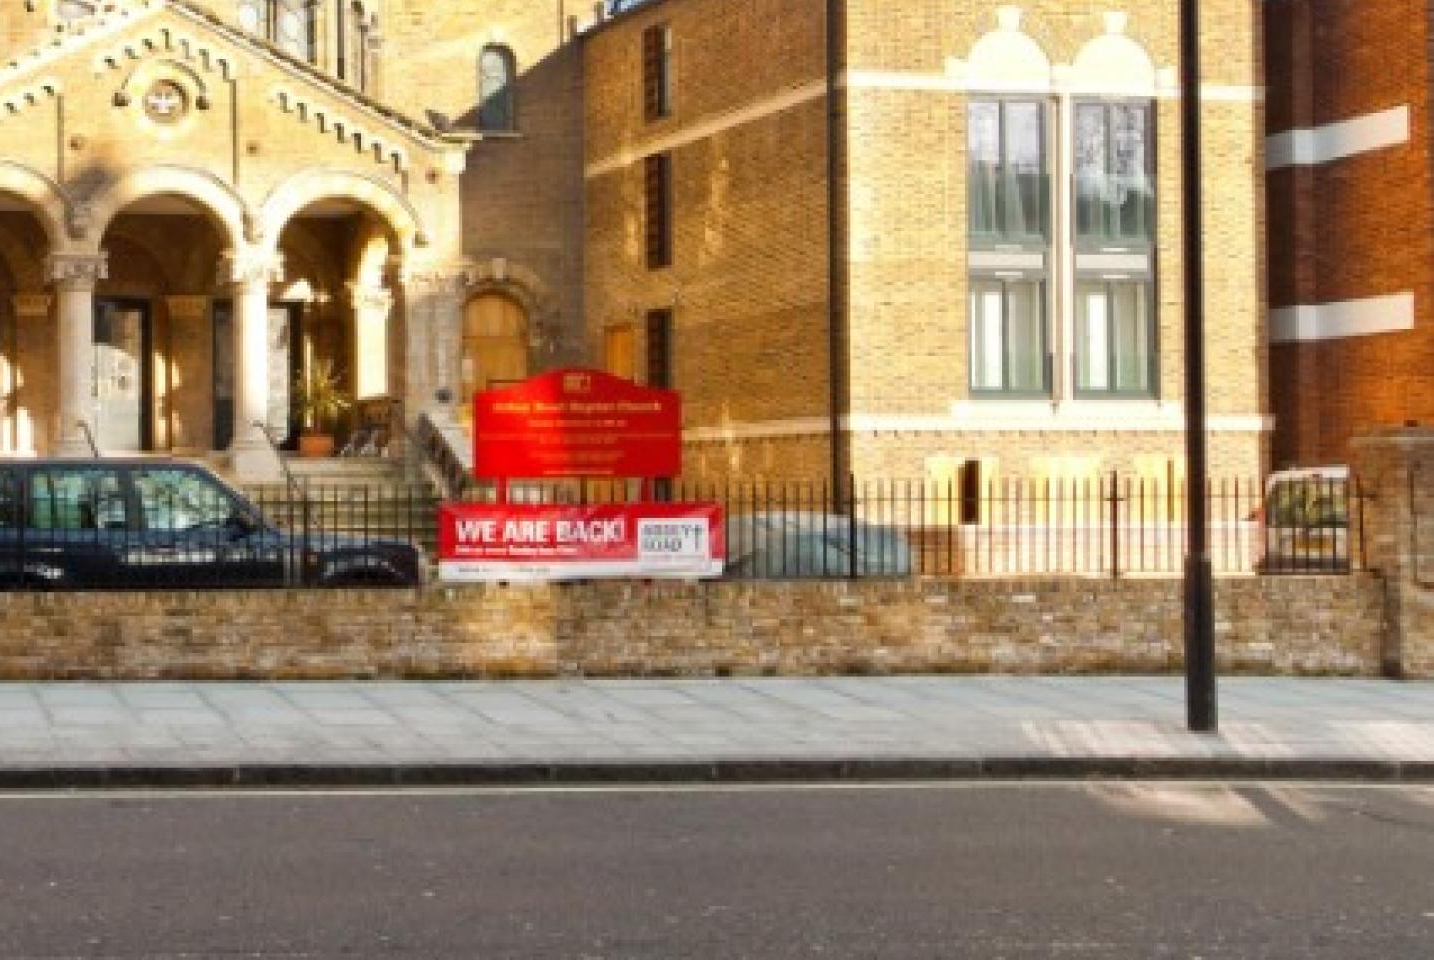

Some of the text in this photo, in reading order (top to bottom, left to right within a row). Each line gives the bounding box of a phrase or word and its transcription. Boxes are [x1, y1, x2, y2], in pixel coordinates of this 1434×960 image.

[455, 520, 626, 543] WE ARE BACK!
